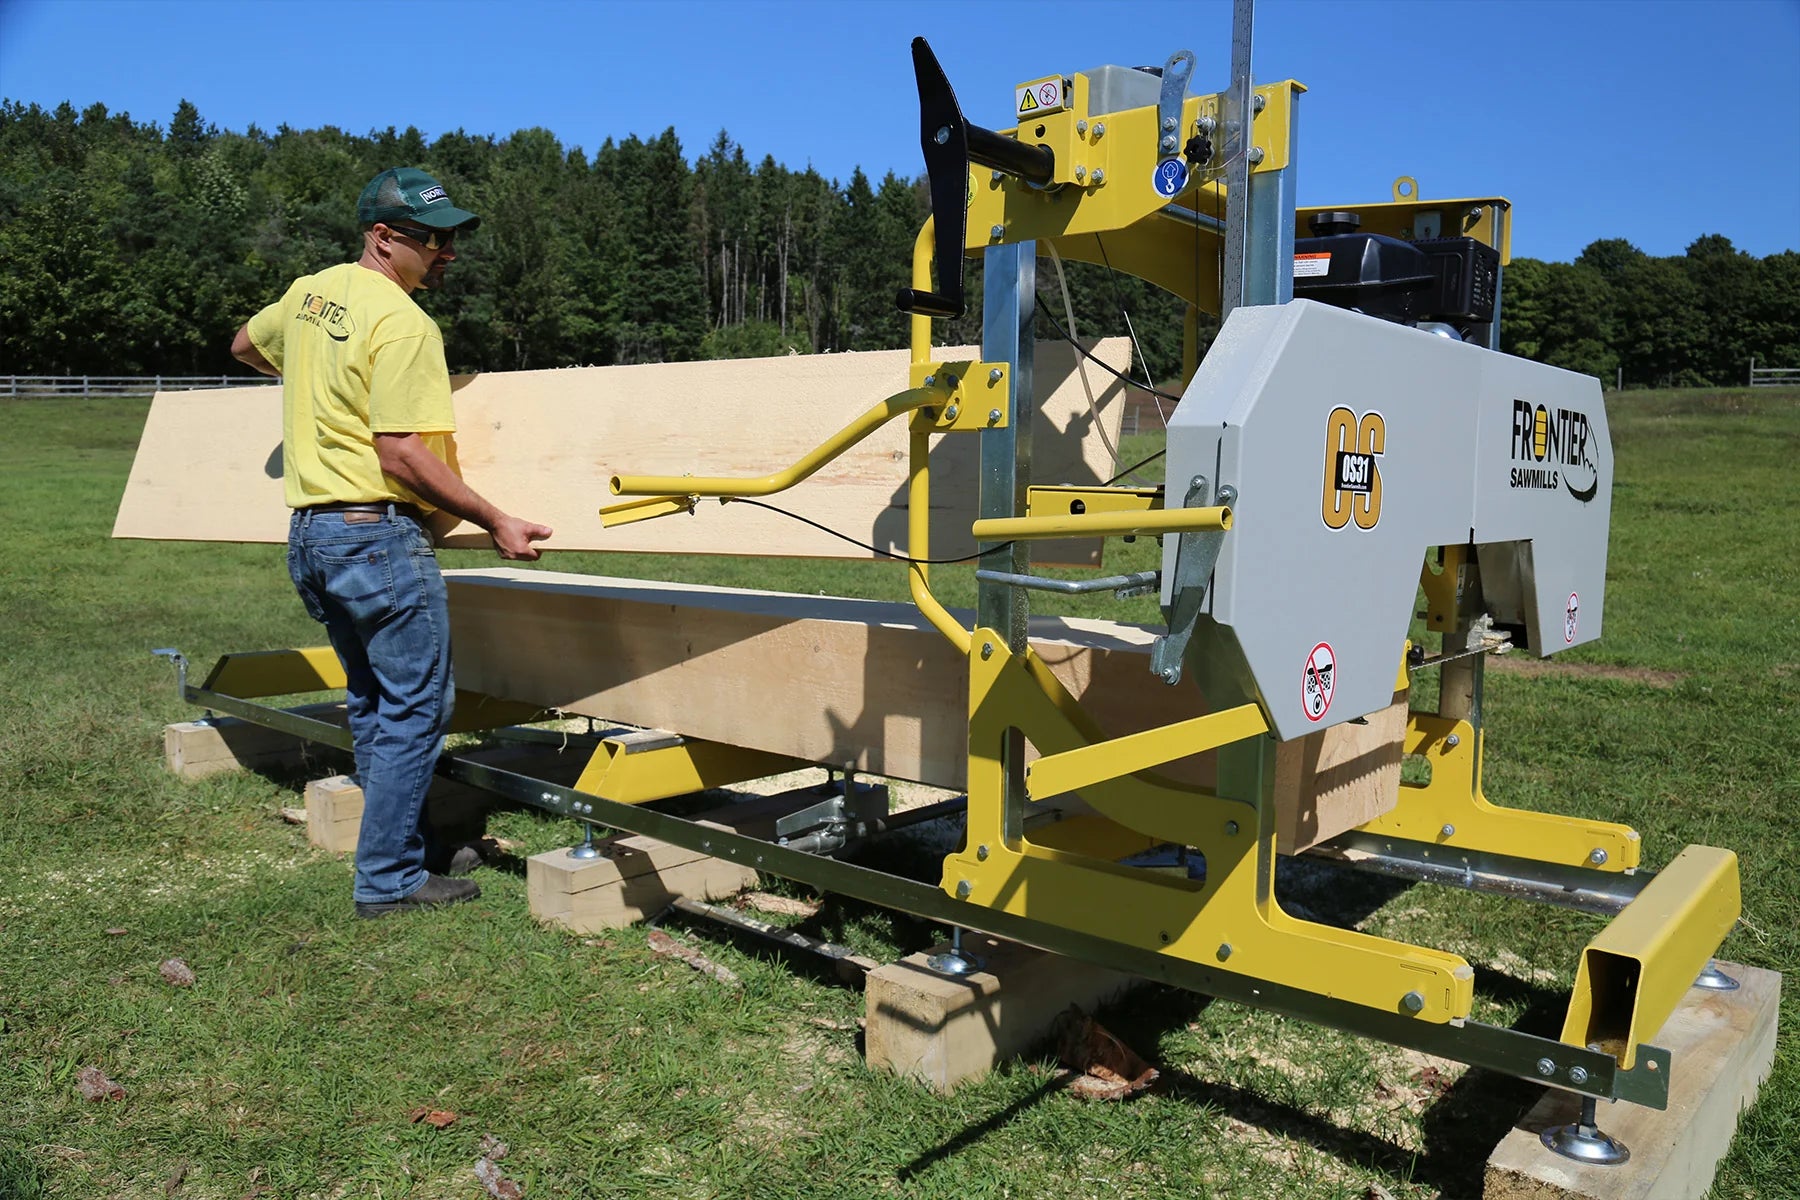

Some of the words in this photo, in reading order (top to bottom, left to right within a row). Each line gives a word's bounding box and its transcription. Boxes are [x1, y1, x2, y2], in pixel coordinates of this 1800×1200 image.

[1511, 399, 1589, 470] FRONTIER
[1342, 454, 1370, 484] OS31
[1510, 467, 1559, 490] SAWMILLS
